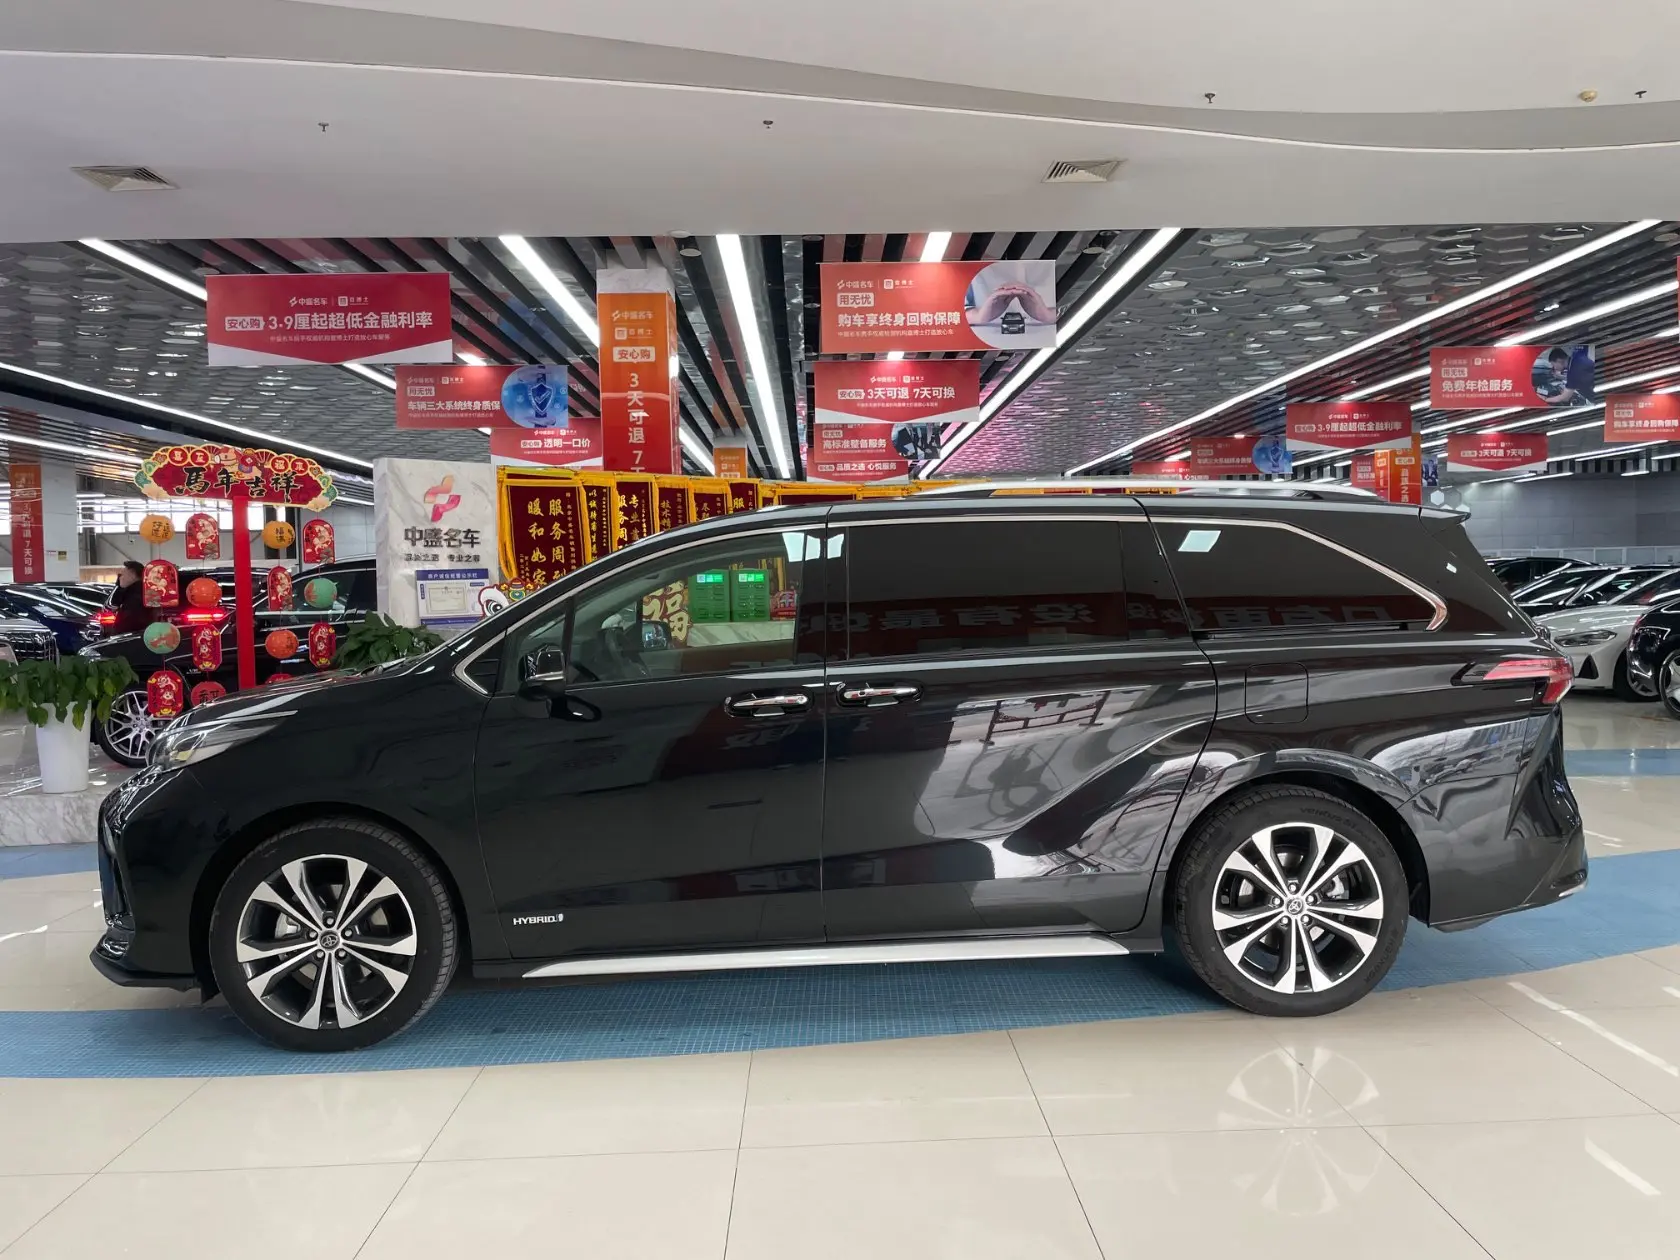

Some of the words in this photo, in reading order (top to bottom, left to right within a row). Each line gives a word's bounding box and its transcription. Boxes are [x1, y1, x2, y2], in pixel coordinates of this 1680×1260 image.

[839, 294, 872, 305] 用无忧
[227, 318, 262, 330] 安心购
[268, 311, 433, 331] 3.9厘起超低金融利率
[837, 311, 961, 327] 购车享终身回购保障
[618, 348, 651, 360] 安心购
[867, 387, 910, 399] 3天可退
[913, 386, 956, 399] 7天可换
[1441, 378, 1514, 393] 免费年检服务
[407, 400, 501, 411] 车辆三大系统终身质保
[543, 438, 591, 449] 透明一口价
[404, 526, 481, 549] 中盛名车
[526, 496, 548, 583] 暖和如家
[547, 497, 566, 578] 服务周到
[512, 915, 556, 926] HYBRID
